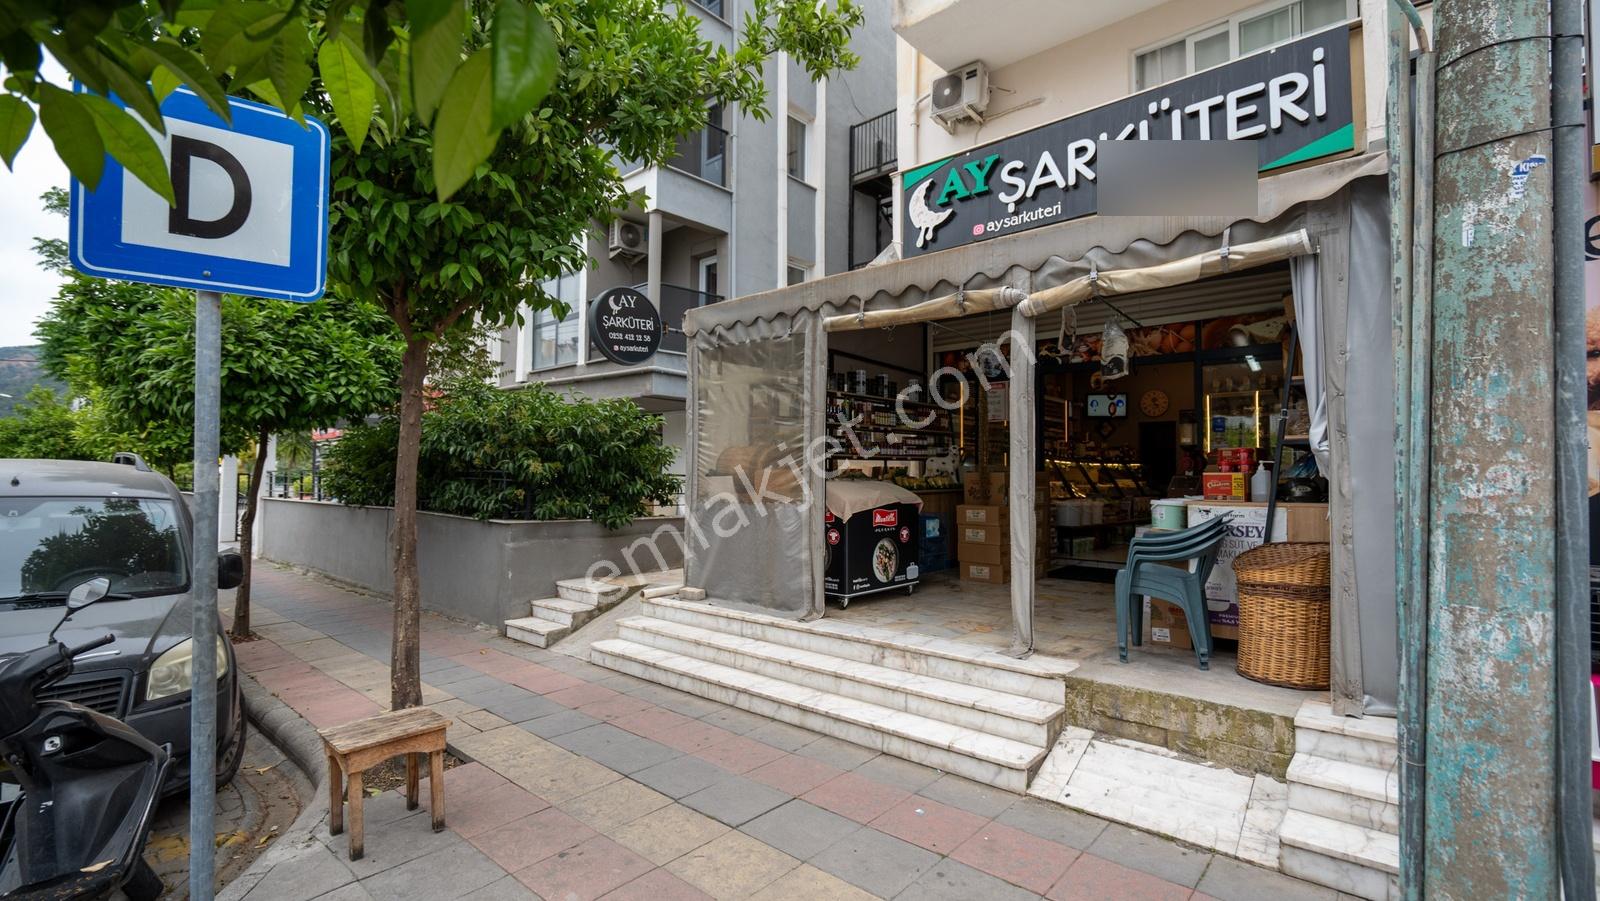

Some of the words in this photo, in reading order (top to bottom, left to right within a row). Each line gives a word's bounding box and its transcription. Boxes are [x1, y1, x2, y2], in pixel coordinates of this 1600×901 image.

[936, 153, 1000, 206] AY
[998, 47, 1327, 213] ŞARÜTERİ
[168, 134, 252, 239] D
[986, 202, 1062, 232] aysarkuteri
[618, 294, 637, 308] AY
[602, 315, 654, 331] ŞARKÜTERİ
[619, 344, 649, 353] aysarkuteri
